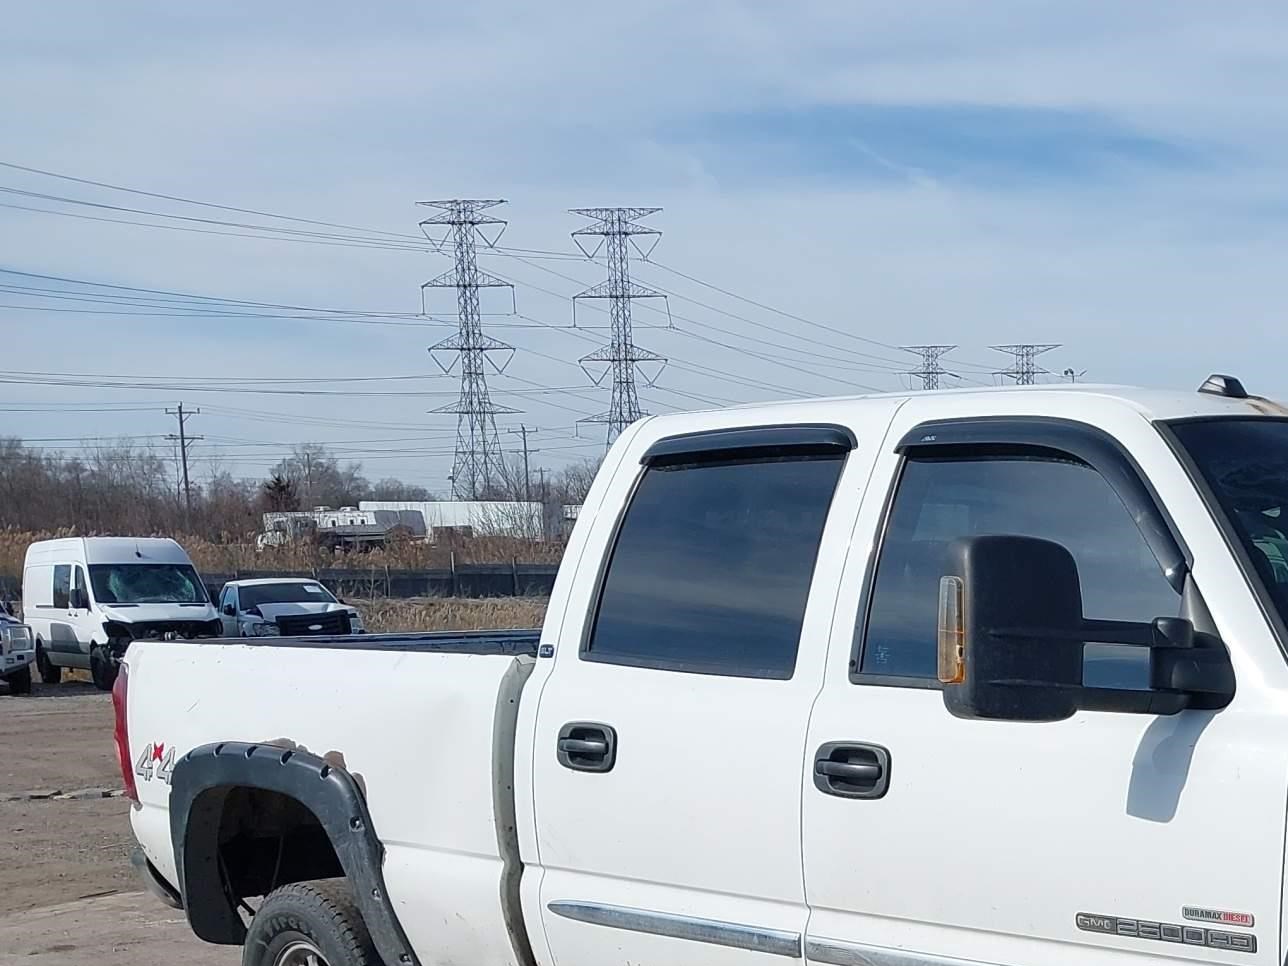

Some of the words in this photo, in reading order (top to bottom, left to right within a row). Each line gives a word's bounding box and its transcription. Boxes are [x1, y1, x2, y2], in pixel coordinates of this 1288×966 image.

[1077, 914, 1112, 931] GMC
[1184, 906, 1222, 921] DURAMAX
[1222, 912, 1251, 924] DIESEL
